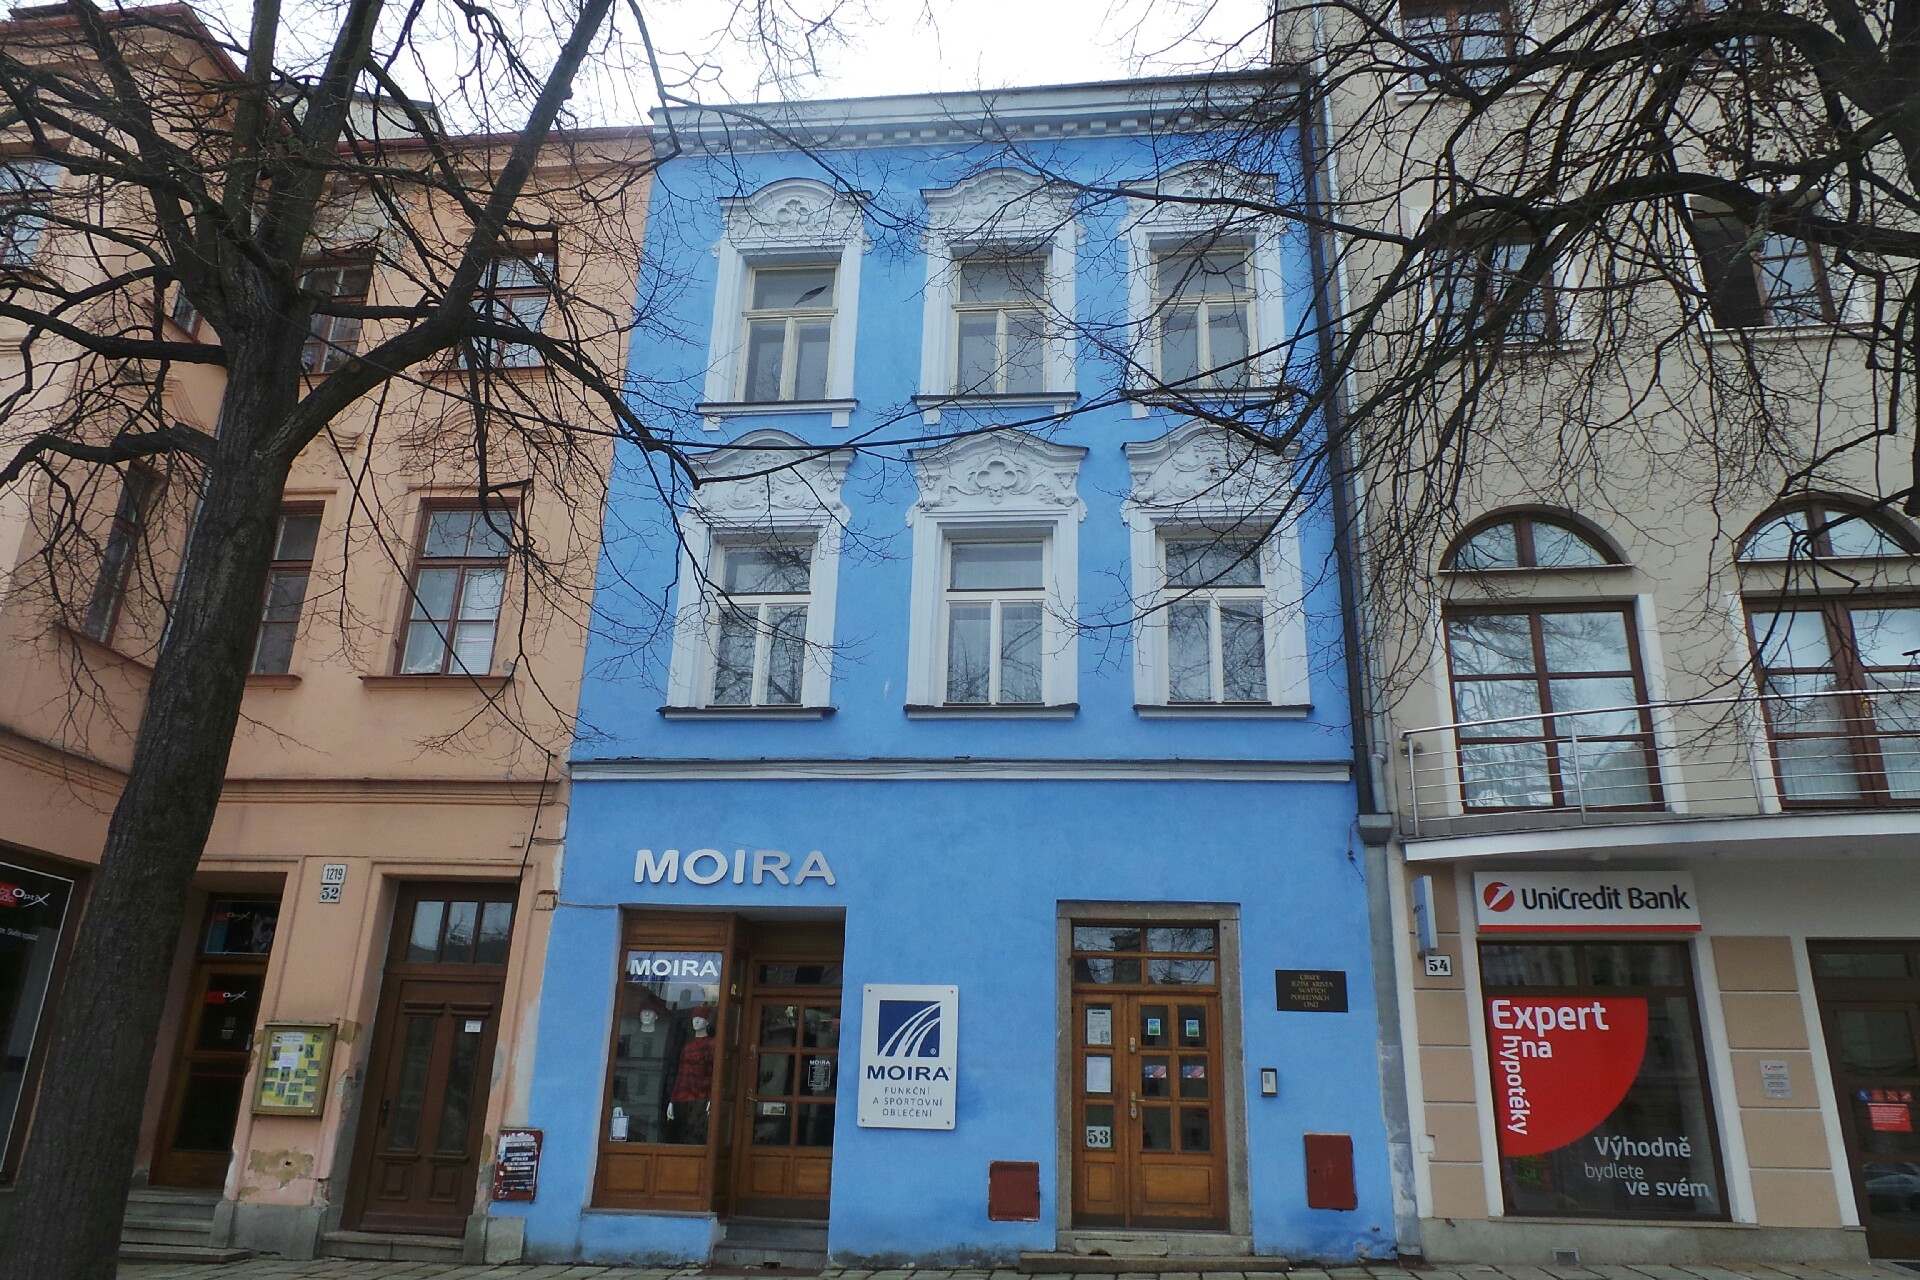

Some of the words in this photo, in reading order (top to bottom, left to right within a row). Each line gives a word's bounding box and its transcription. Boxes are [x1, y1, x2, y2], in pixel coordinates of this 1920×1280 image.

[326, 868, 343, 880] 1219
[634, 849, 836, 886] MOIRA
[321, 887, 339, 900] 52
[1521, 885, 1623, 910] UniCredit
[1627, 884, 1690, 910] Bank
[630, 959, 718, 977] MOIRA
[1428, 959, 1448, 972] 54
[1492, 999, 1609, 1037] Expert
[1521, 1040, 1552, 1058] na
[867, 1065, 949, 1081] MOIRA
[884, 1086, 930, 1095] FUNKČNÍ
[1499, 1035, 1530, 1135] hypotéky
[872, 1097, 879, 1105] A
[884, 1097, 942, 1107] SPORTOVNÍ
[882, 1108, 932, 1117] OBLEČENÍ
[1088, 1129, 1109, 1144] 53
[1594, 1135, 1691, 1160] Výhodně
[1584, 1162, 1644, 1181] bydlete
[1625, 1181, 1650, 1196] ve
[1655, 1177, 1710, 1197] svém
